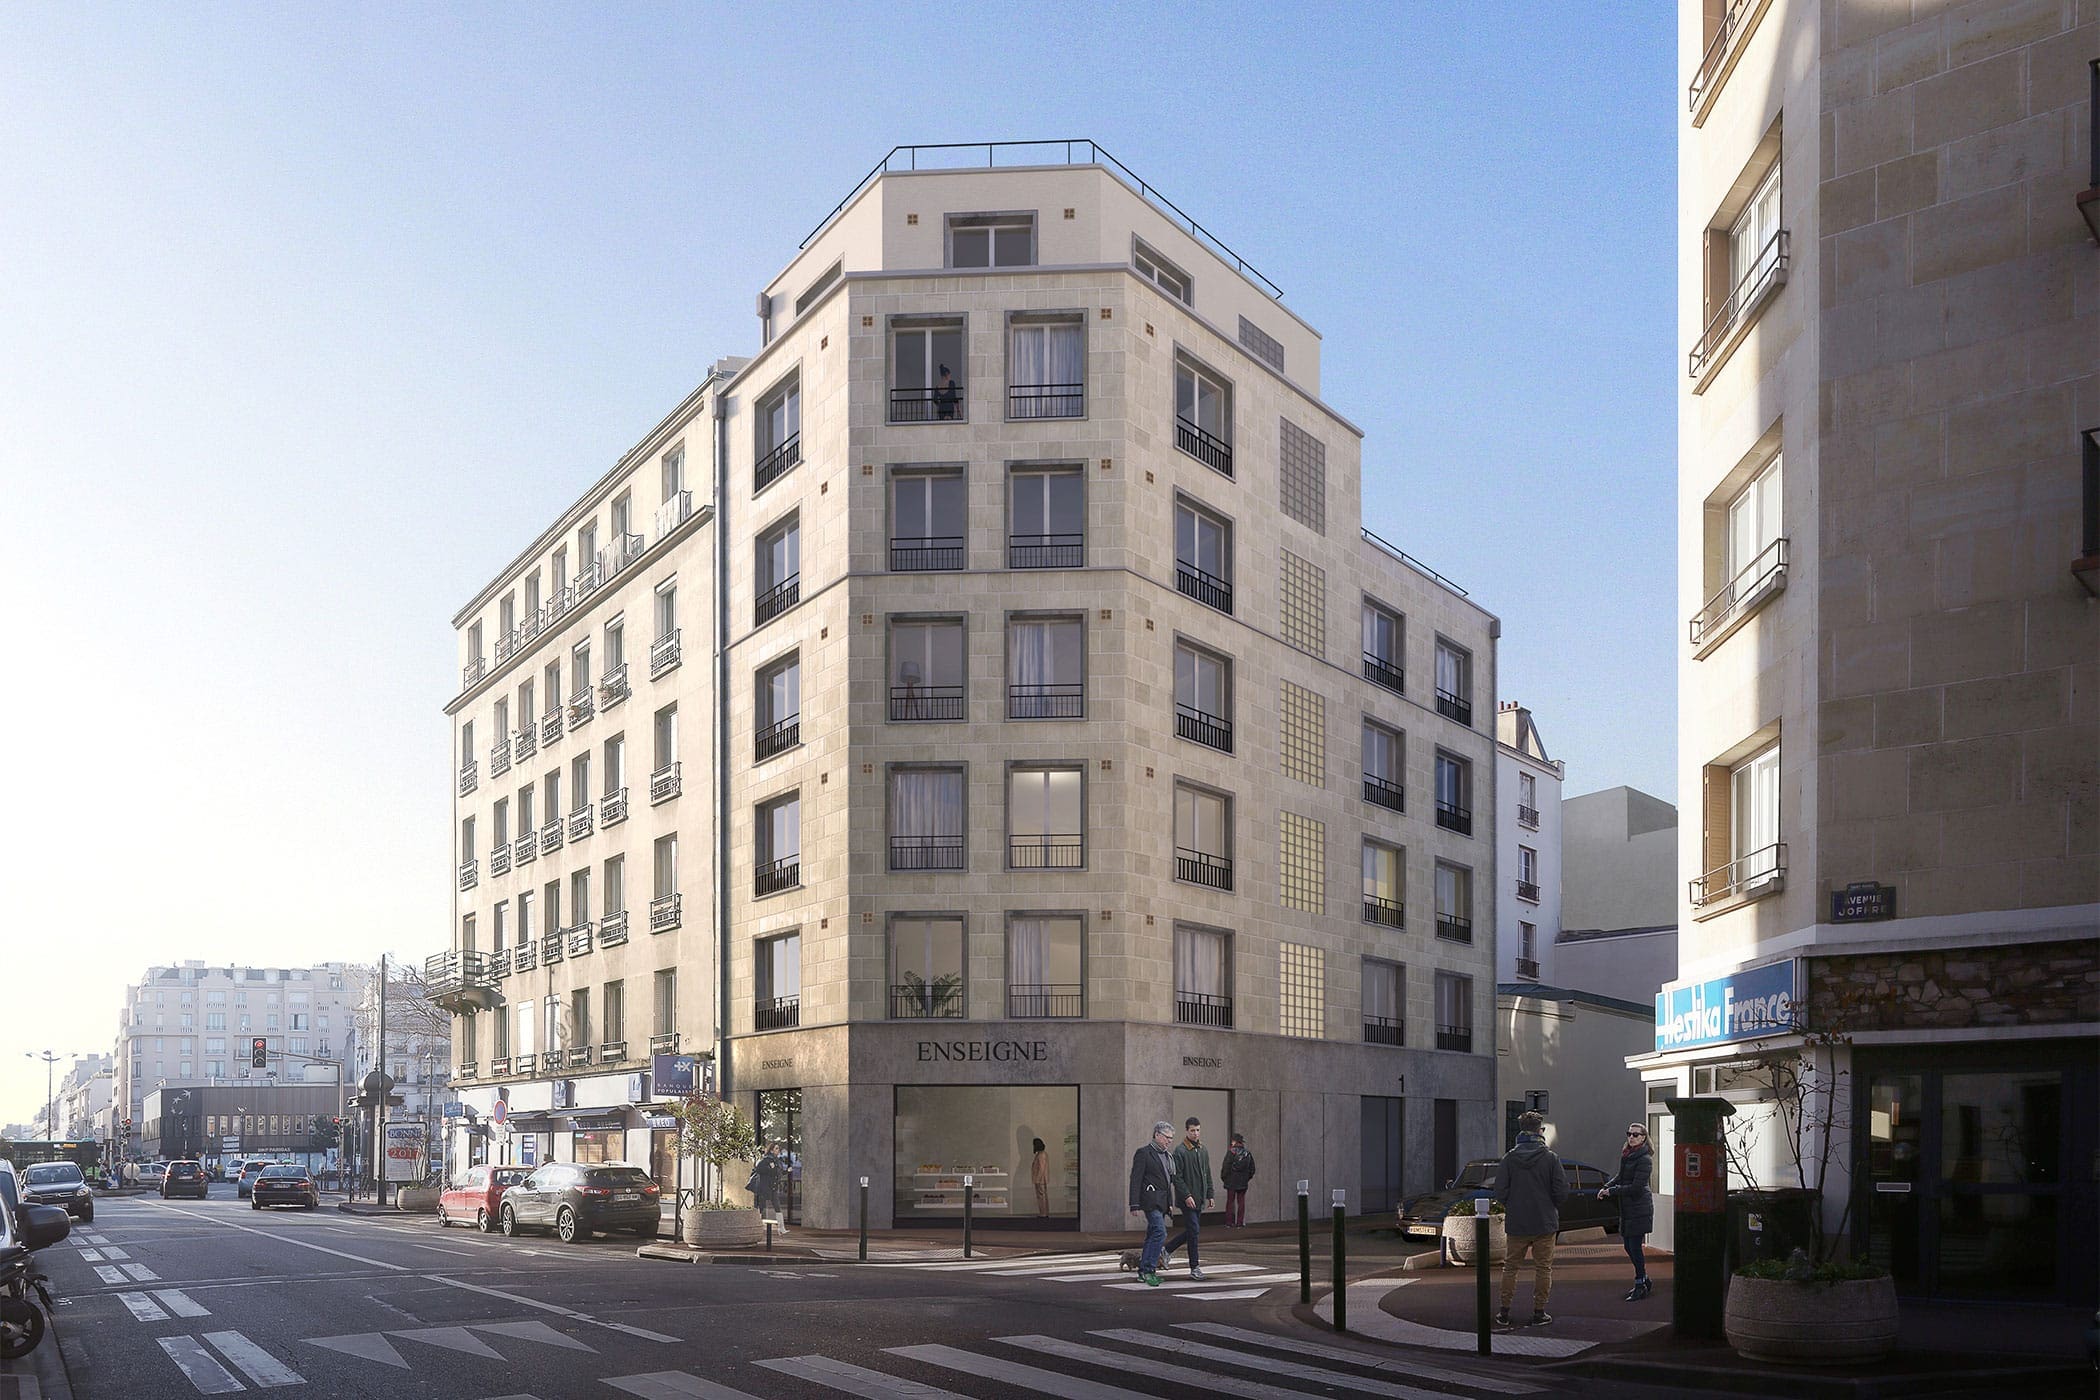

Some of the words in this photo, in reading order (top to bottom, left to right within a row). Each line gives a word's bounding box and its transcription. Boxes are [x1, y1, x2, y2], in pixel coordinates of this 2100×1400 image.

[1845, 894, 1882, 905] AVENUE
[1656, 981, 1721, 1045] Hestika
[1724, 986, 1791, 1035] France
[917, 1040, 1048, 1062] ENSEIGNE
[761, 1057, 793, 1070] ENSEIGNE
[1182, 1055, 1222, 1069] ENSEIGNE
